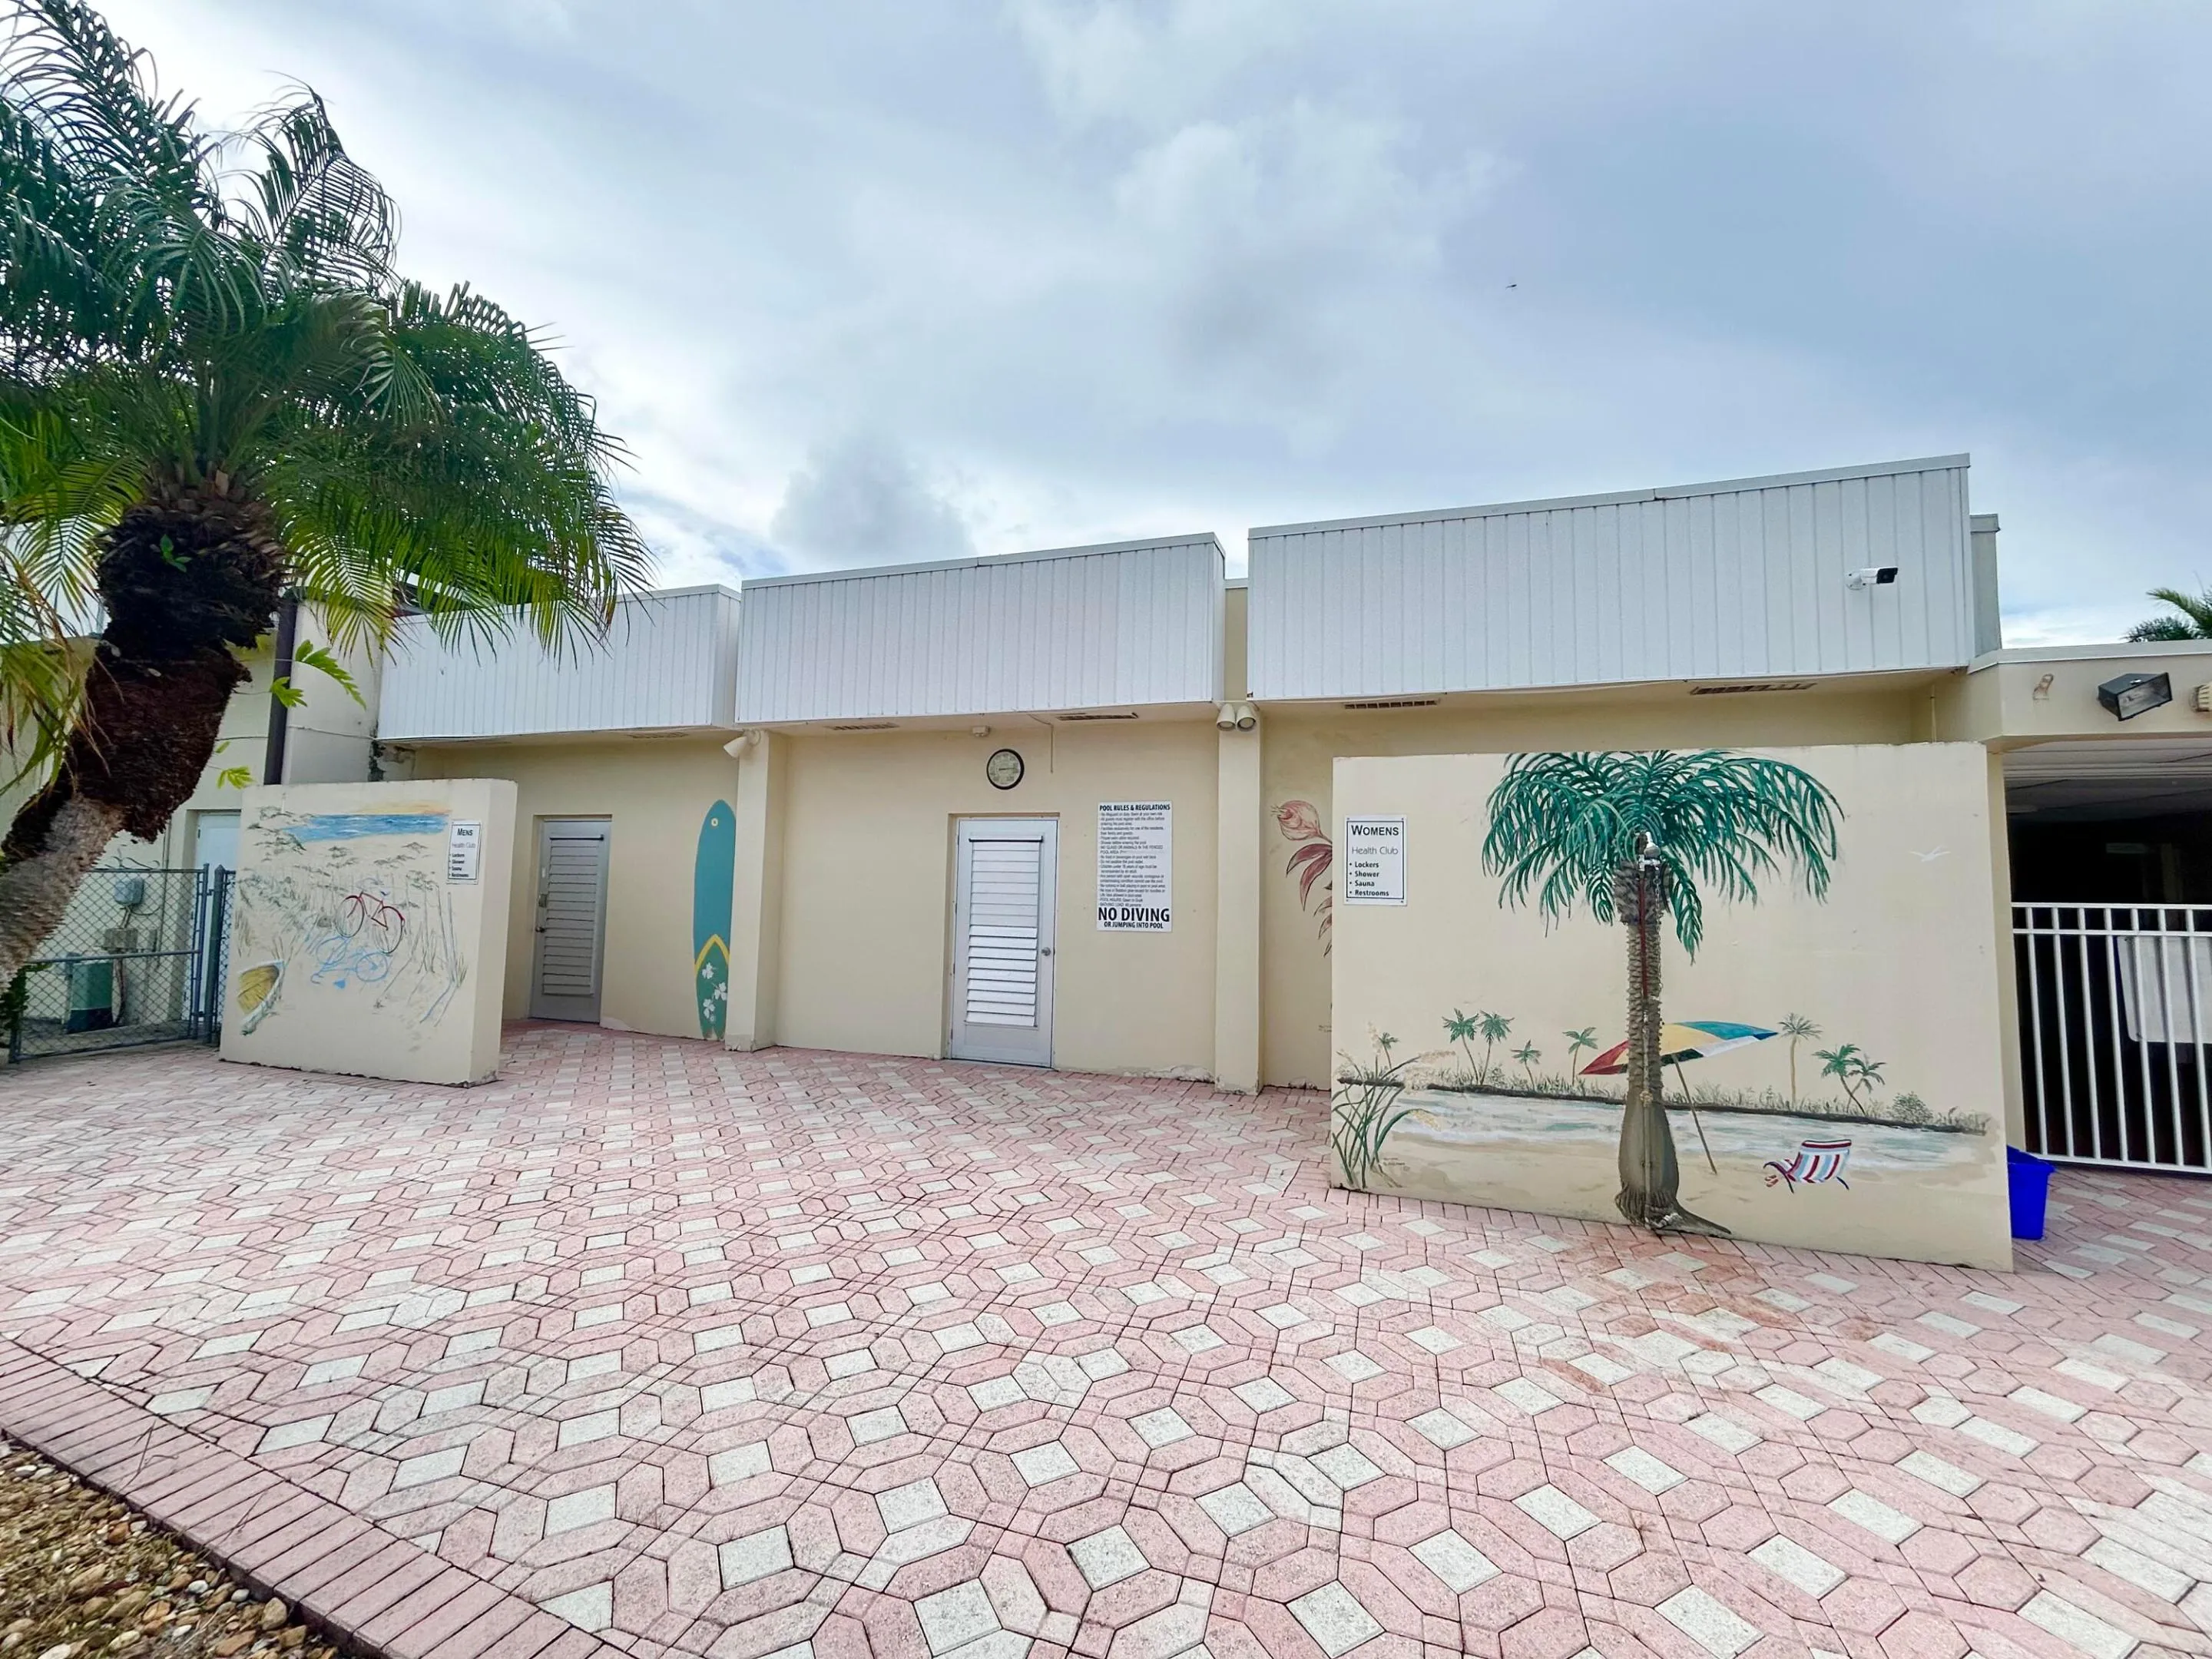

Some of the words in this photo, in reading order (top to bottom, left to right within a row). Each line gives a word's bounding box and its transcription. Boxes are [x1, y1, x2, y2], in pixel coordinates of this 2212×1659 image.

[1351, 825, 1399, 836] WOMENS
[1352, 846, 1377, 855] Health
[1379, 846, 1399, 855] Club
[1098, 907, 1117, 920] NO
[1121, 907, 1170, 922] DIVING
